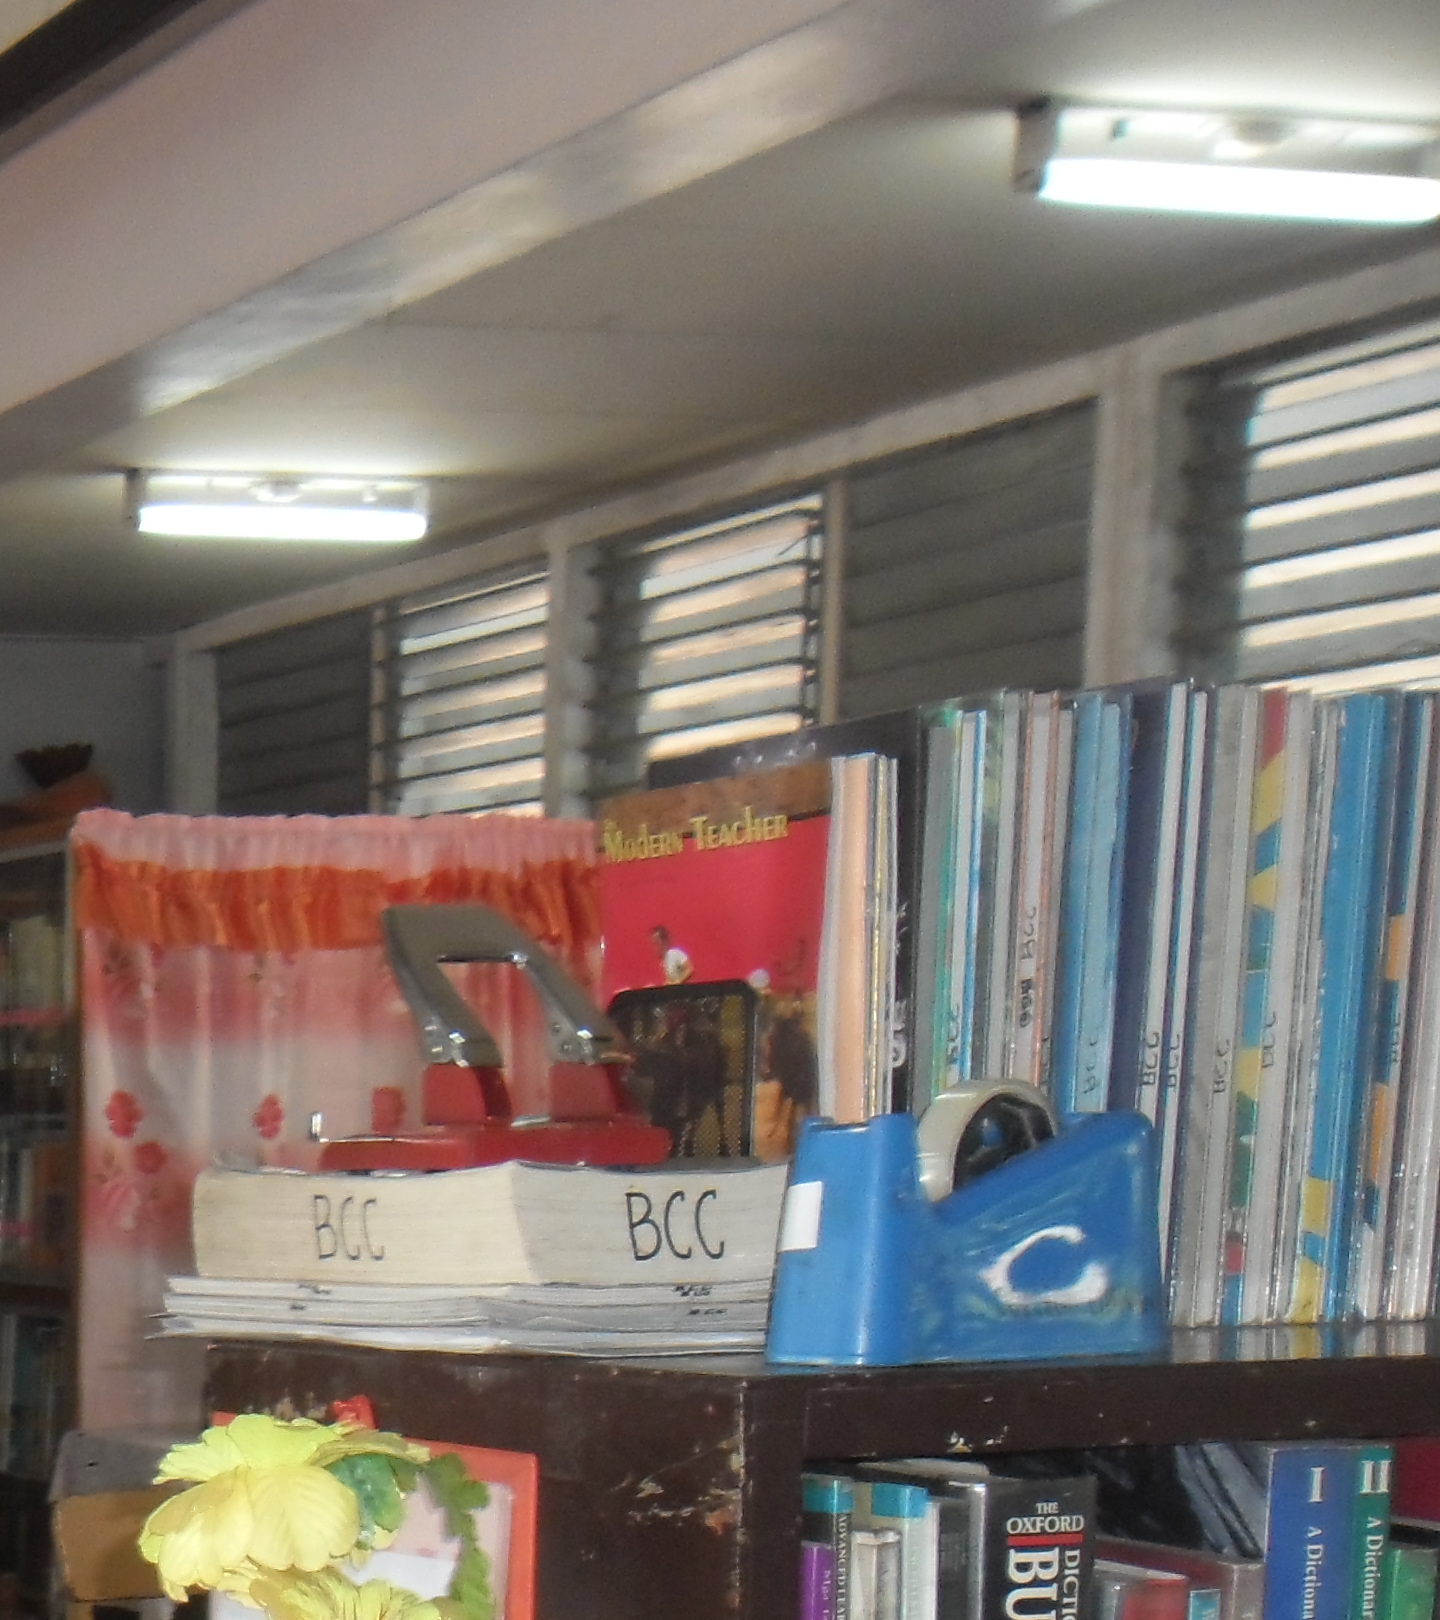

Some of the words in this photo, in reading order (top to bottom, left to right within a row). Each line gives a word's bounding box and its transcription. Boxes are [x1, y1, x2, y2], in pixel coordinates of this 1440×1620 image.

[313, 1194, 386, 1262] BCC
[626, 1188, 726, 1262] BCC
[1006, 1515, 1084, 1535] OXFORD
[1035, 1502, 1059, 1514] THE
